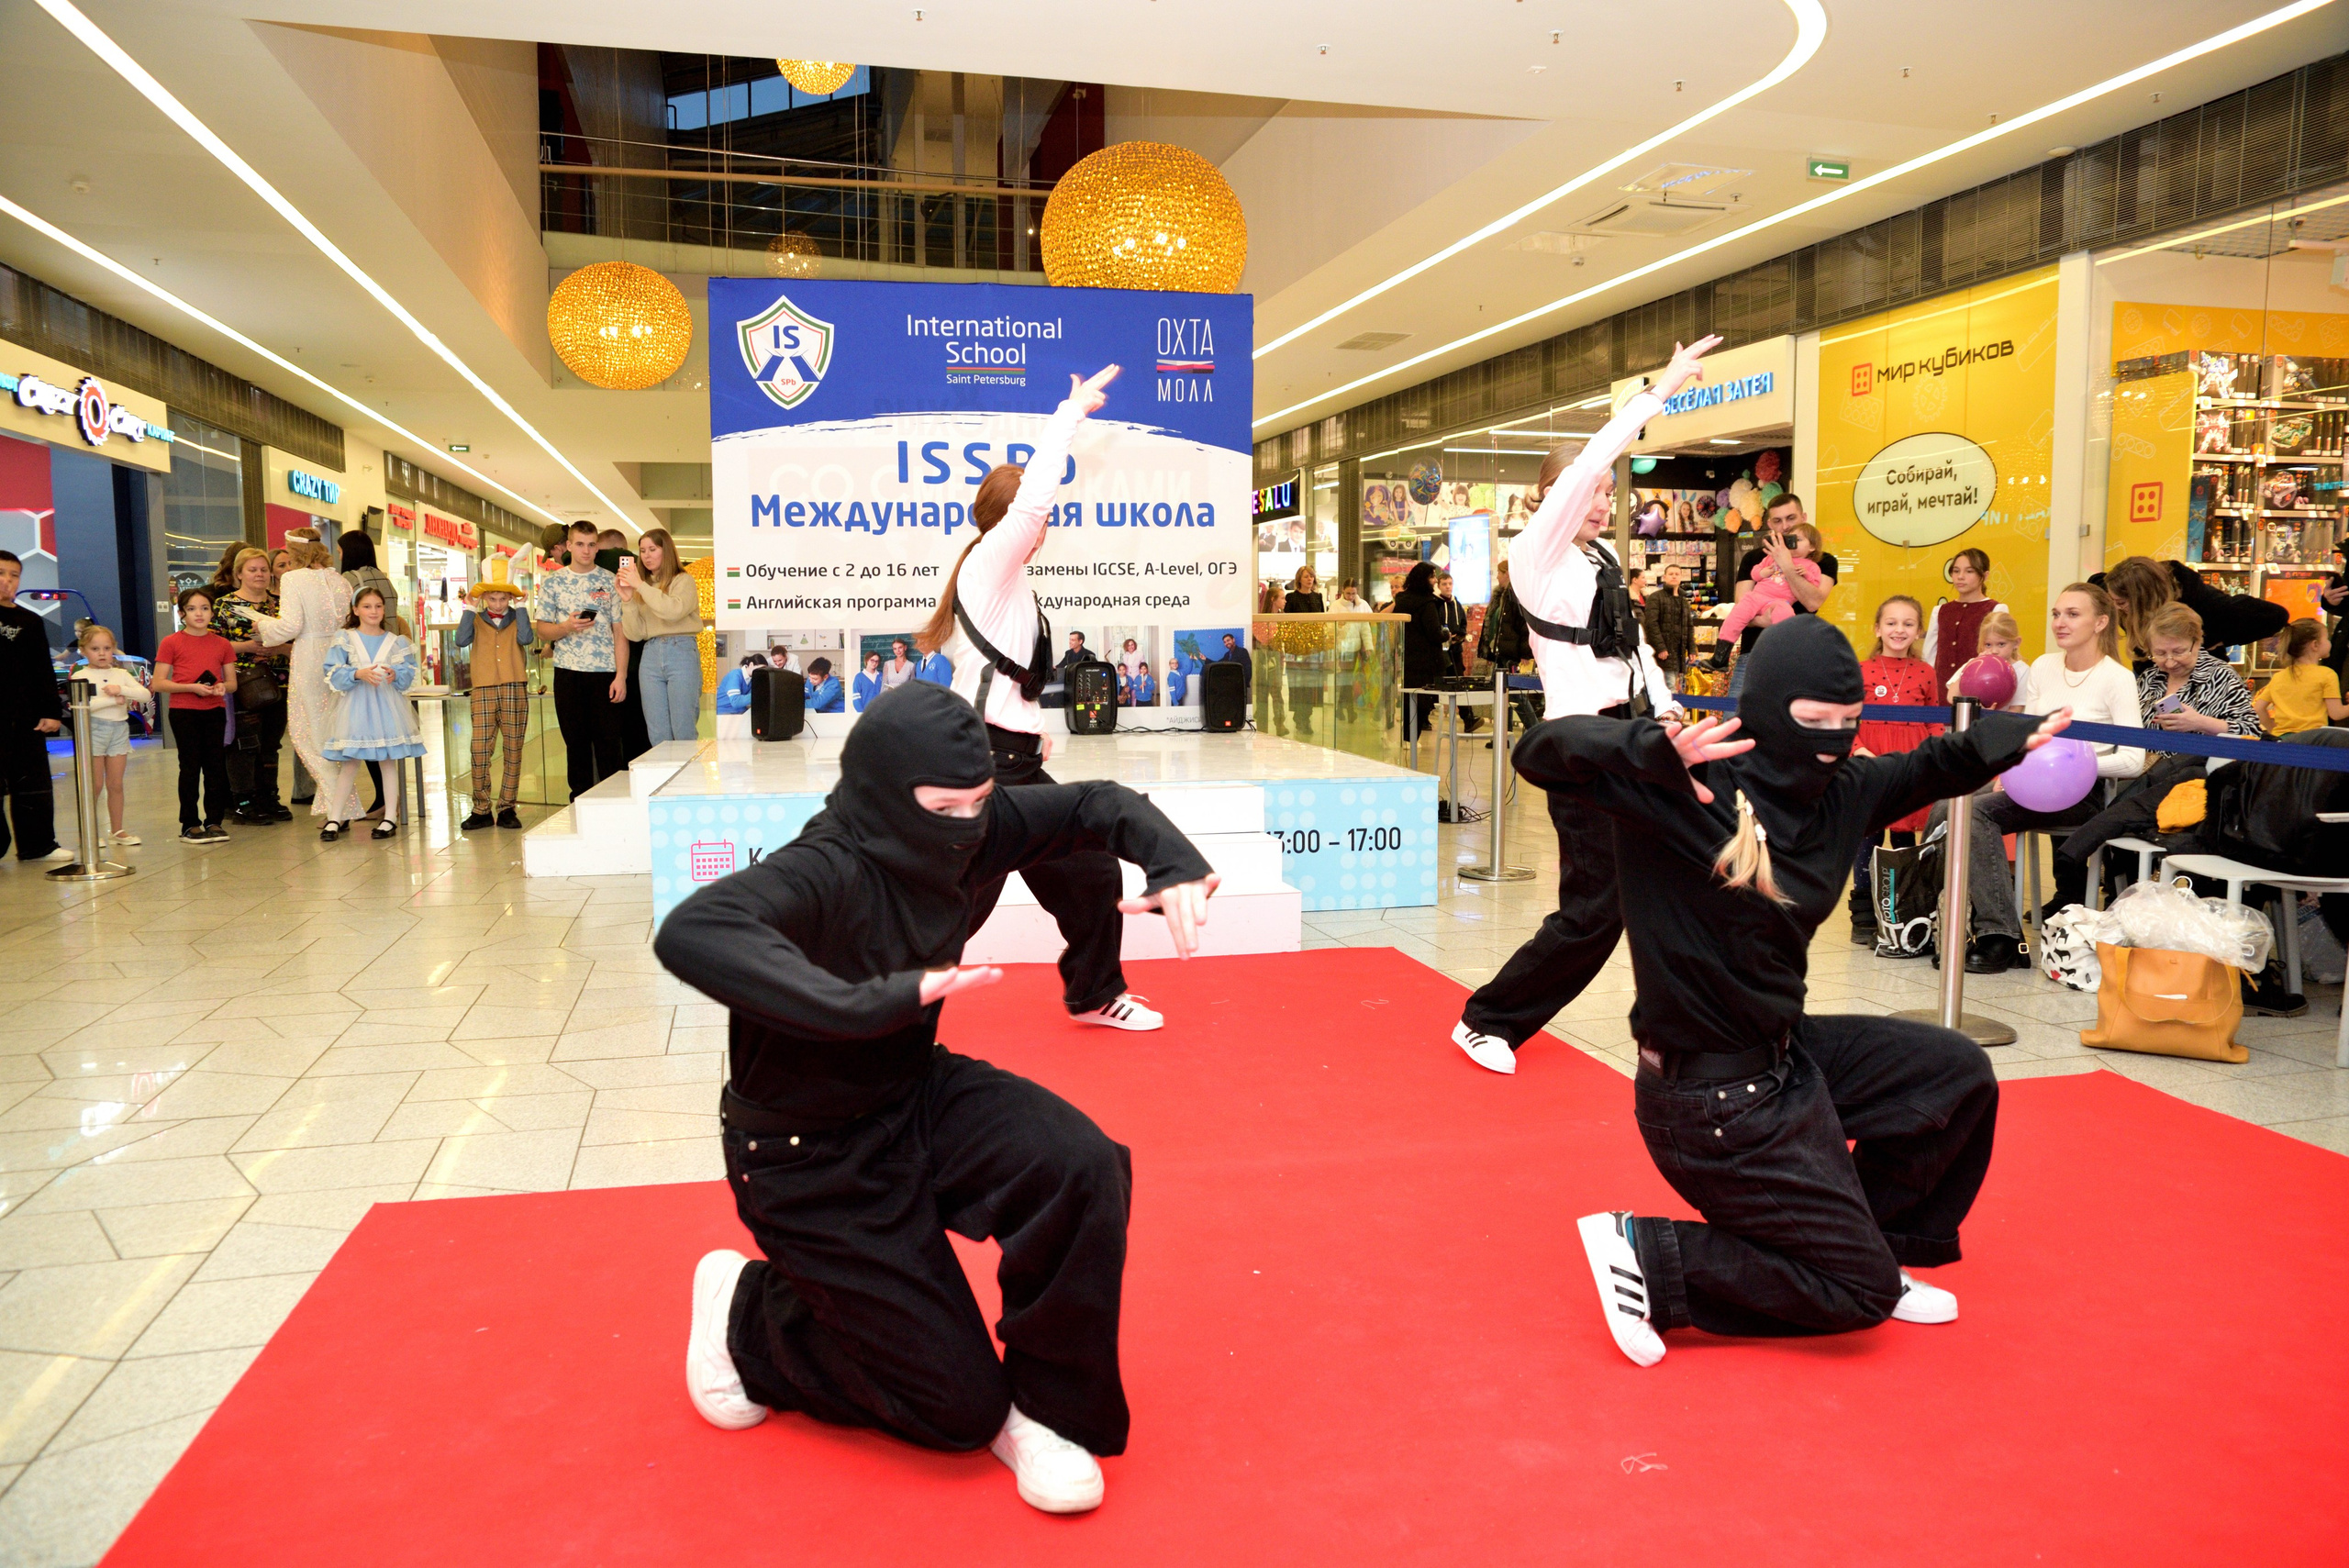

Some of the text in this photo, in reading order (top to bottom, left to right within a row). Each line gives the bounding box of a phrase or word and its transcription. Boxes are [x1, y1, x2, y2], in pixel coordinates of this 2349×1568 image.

[773, 325, 801, 350] IS
[907, 314, 1063, 339] International
[1157, 317, 1214, 356] ОХТА
[945, 341, 1027, 365] School
[1877, 339, 2015, 384] мир кубиков
[780, 378, 796, 386] SPb
[946, 373, 1027, 387] Saint Petersburg
[1157, 377, 1213, 402] МОЛЛ
[1662, 384, 1723, 416] ВЕСЁЛАЯ
[1725, 372, 1774, 403] ЗАТЕЯ
[1887, 459, 1958, 485] Собирай,
[293, 469, 340, 505] CRAZY ТИР
[1867, 485, 1978, 517] играй, мечтай!
[1095, 502, 1216, 528] школа
[746, 563, 940, 581] Обучение с 2 до 16 лет
[1093, 562, 1140, 577] IGCSE,
[1144, 562, 1203, 577] A-Level,
[1208, 562, 1238, 575] ОГЭ
[746, 595, 937, 612] Английская программа
[1145, 595, 1190, 608] среда
[1347, 826, 1401, 852] 17:00
